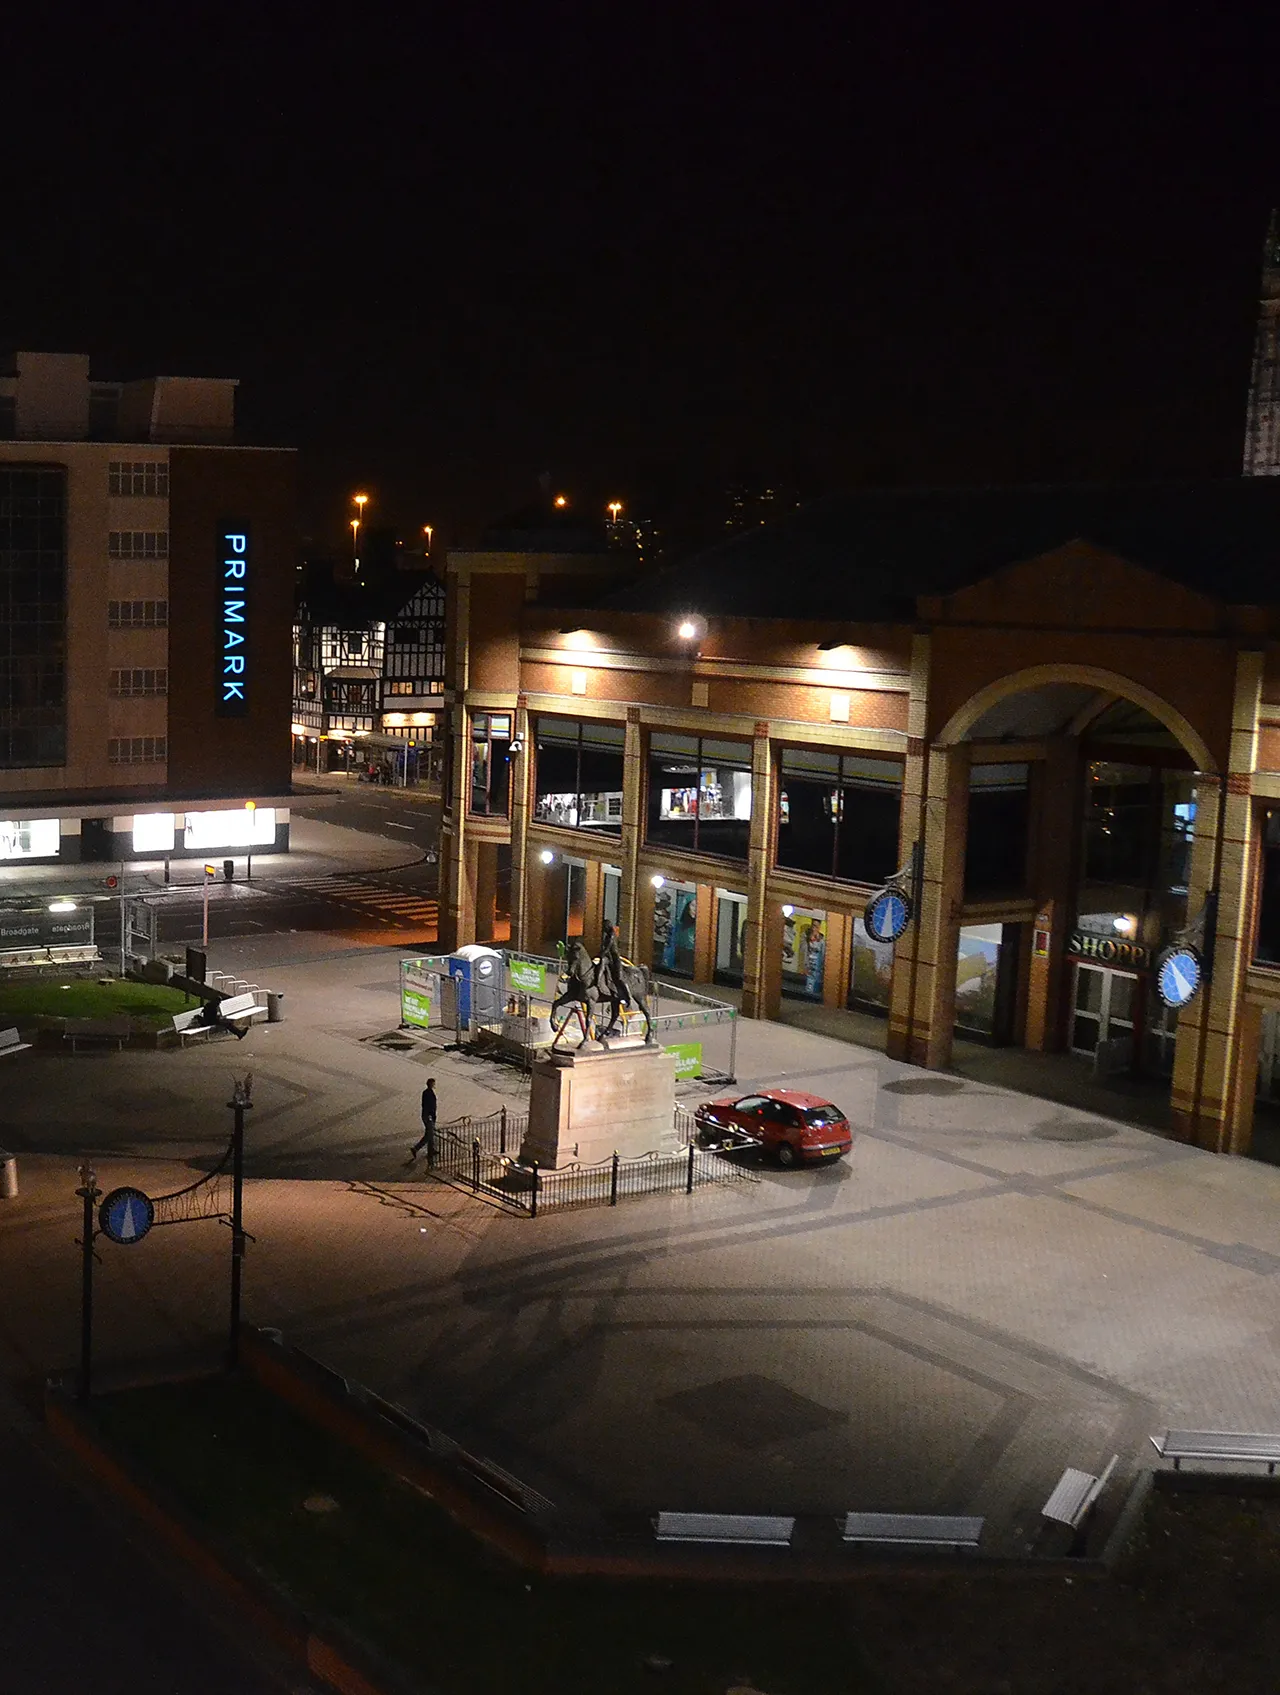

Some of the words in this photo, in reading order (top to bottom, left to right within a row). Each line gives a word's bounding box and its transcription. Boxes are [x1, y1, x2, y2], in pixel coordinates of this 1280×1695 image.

[223, 534, 246, 700] PRIMARK
[1, 927, 39, 936] Broadgate
[1069, 934, 1151, 968] SHOPPI
